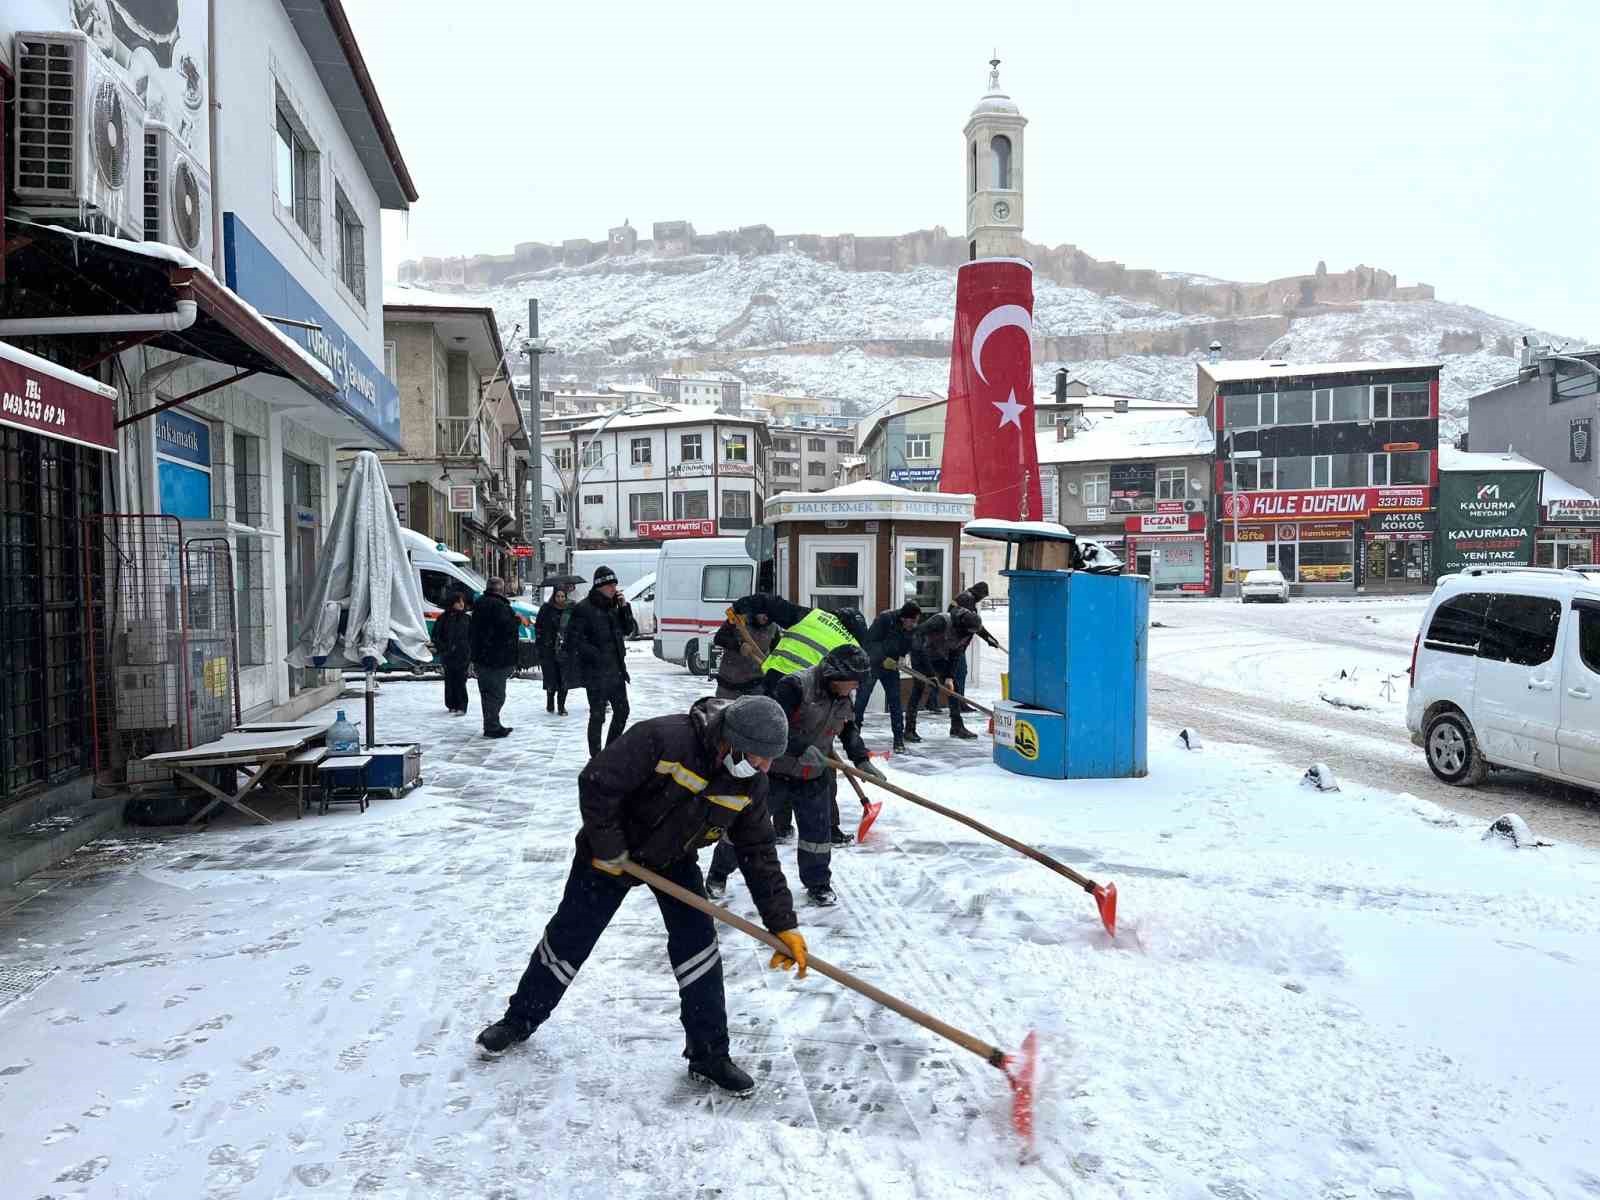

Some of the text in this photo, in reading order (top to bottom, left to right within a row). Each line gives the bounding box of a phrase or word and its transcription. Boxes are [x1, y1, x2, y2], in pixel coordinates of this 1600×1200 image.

[25, 379, 41, 400] TEL:
[23, 399, 41, 421] 333
[44, 404, 55, 423] 69
[56, 407, 66, 426] 24
[156, 421, 199, 452] ankamatik
[797, 502, 873, 513] HALK EKMEK
[1253, 496, 1298, 514] KULE
[1460, 502, 1516, 510] KAVURMA
[1143, 516, 1186, 525] ECZANE
[1384, 513, 1422, 521] AKTAR
[651, 523, 676, 531] SAADET
[1448, 529, 1528, 540] KAVURMADA
[1463, 551, 1515, 560] YENİ TARZ
